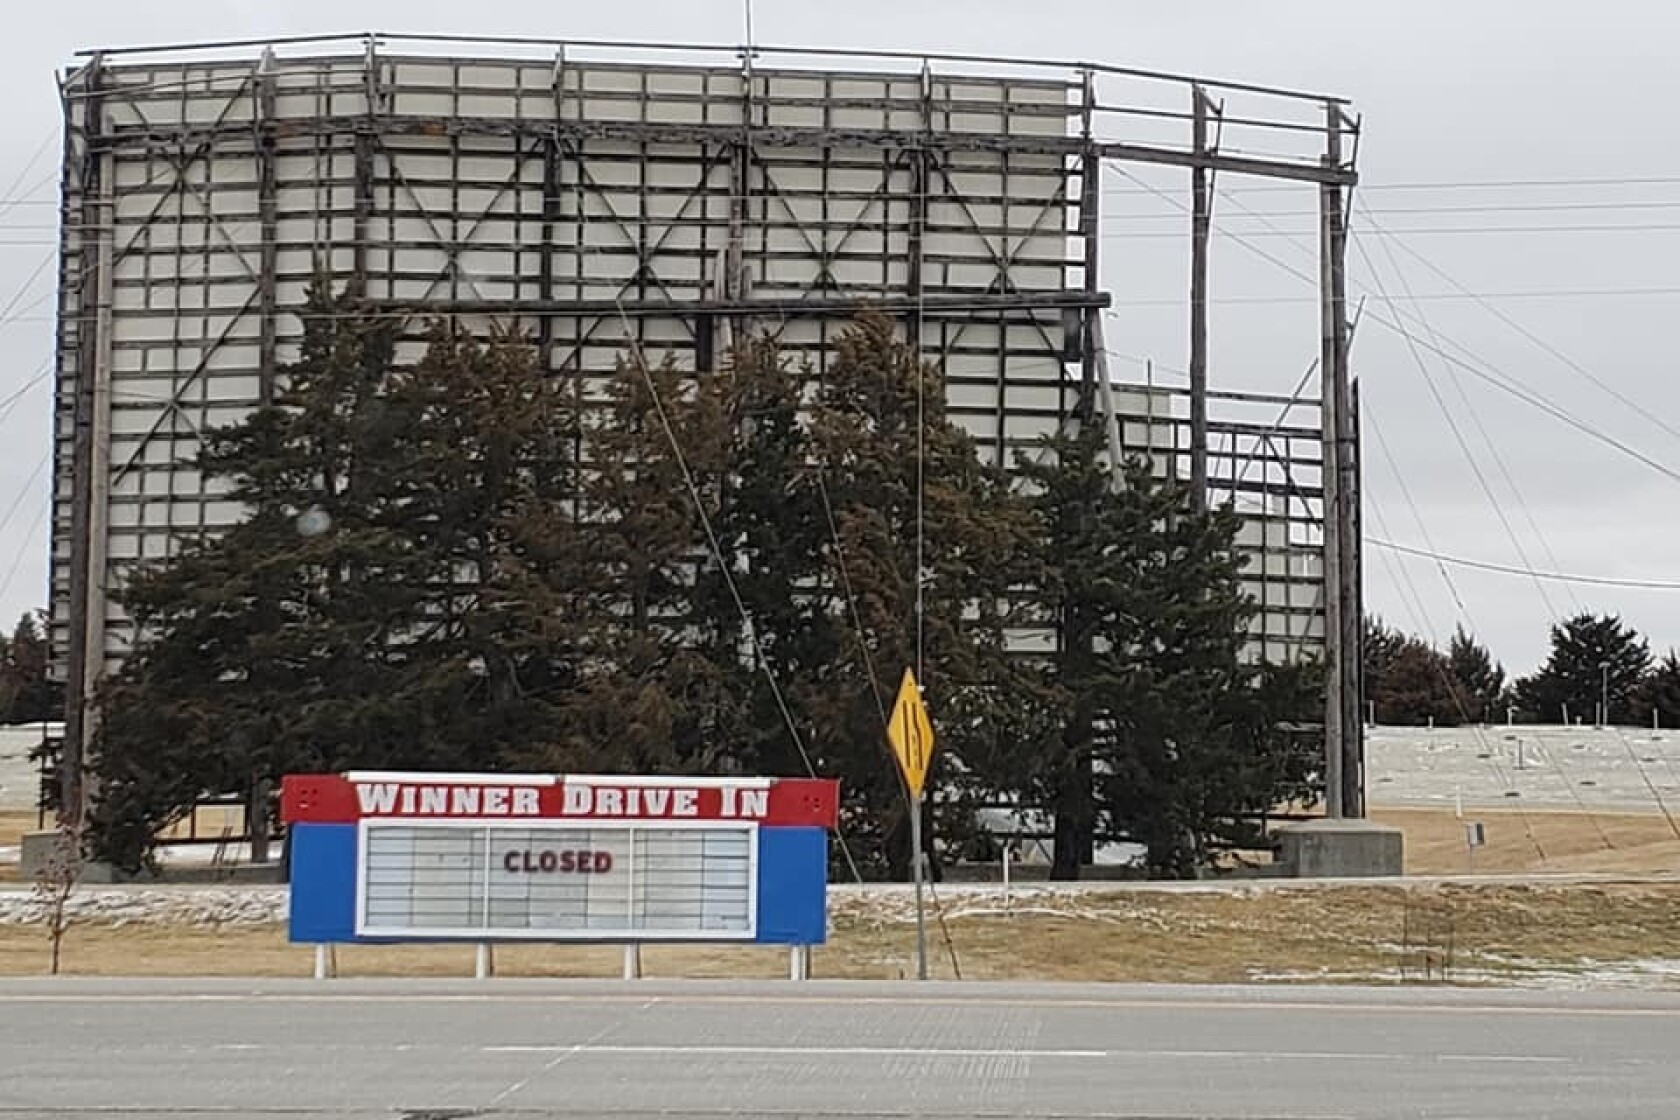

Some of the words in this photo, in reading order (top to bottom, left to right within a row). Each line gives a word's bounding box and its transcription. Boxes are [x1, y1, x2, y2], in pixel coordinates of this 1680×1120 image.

[356, 783, 540, 815] WINNER
[562, 784, 699, 816] DRIVE
[720, 786, 769, 818] IN
[503, 850, 612, 874] CLOSED
